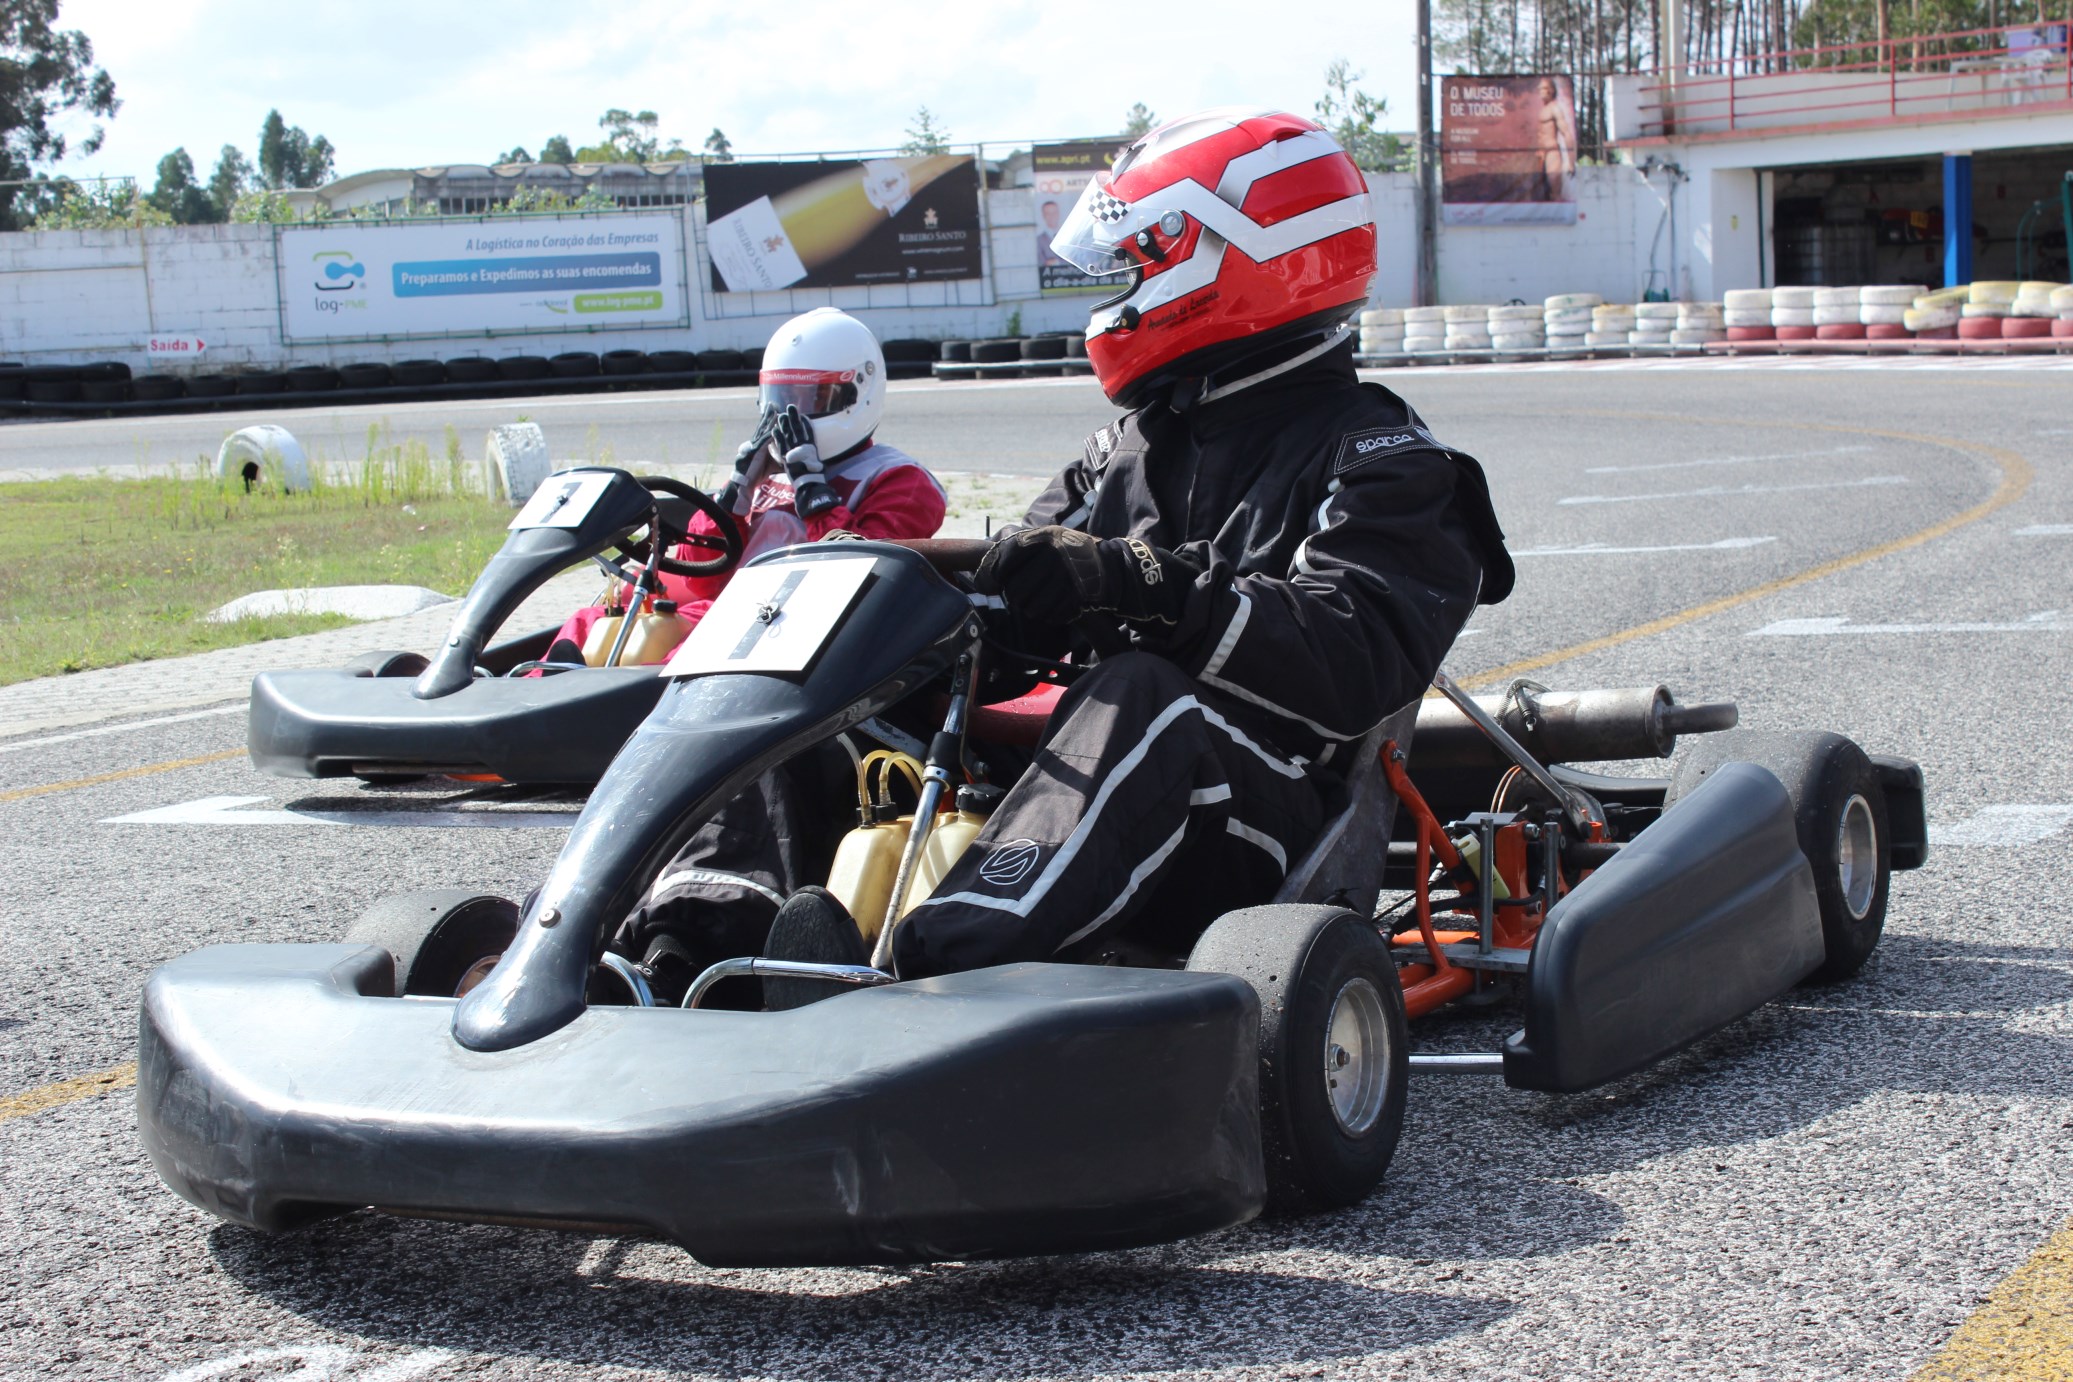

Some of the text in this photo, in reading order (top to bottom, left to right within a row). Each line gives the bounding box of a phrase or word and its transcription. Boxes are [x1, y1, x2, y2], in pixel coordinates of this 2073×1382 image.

[1463, 86, 1504, 100] MUSEU
[1450, 103, 1505, 116] DE TODOS
[465, 239, 473, 251] A
[526, 239, 540, 248] no
[587, 233, 605, 246] das
[607, 232, 658, 247] Empresas
[935, 230, 967, 241] SANTO
[401, 262, 652, 287] Preparamos e Expedimos as suas encomendas
[1355, 434, 1415, 454] sparco
